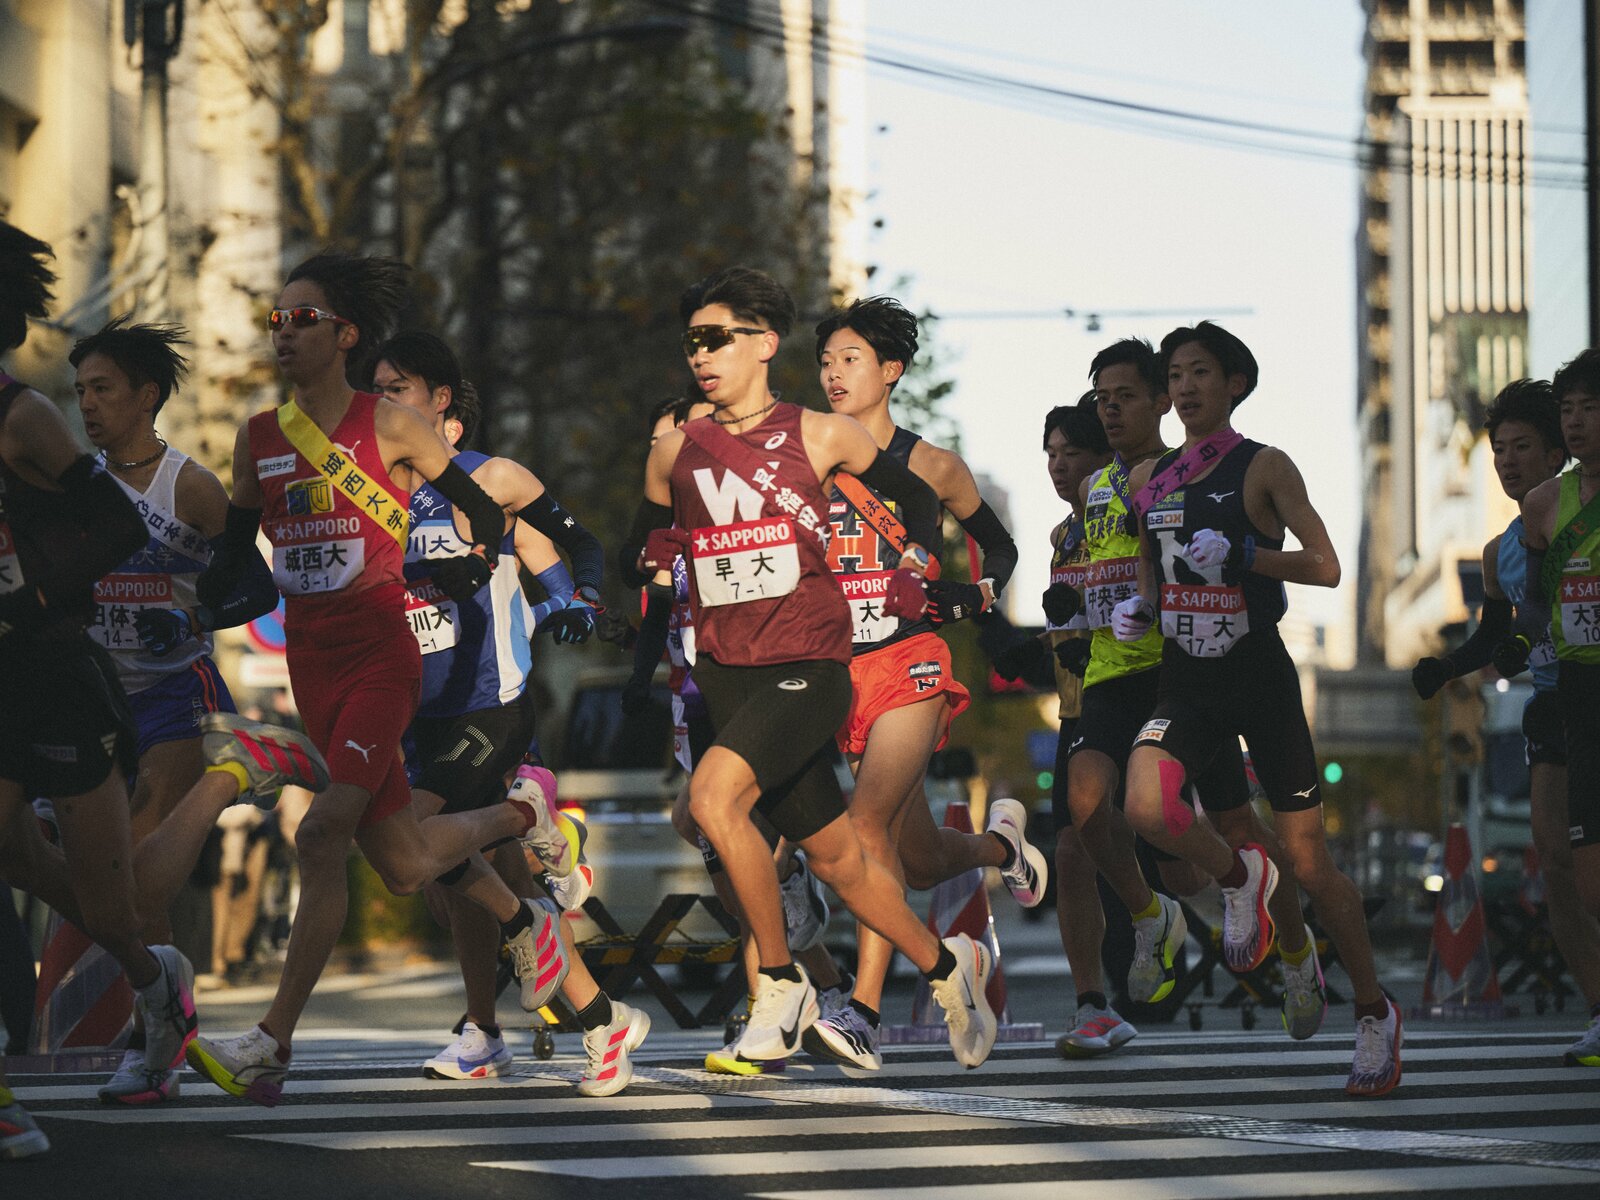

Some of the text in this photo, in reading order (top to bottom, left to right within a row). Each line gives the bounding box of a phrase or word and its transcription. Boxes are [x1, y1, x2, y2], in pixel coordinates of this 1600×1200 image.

[320, 452, 403, 531] 城西大学
[287, 516, 361, 540] SAPPORO
[711, 522, 790, 551] SAPPORO
[826, 520, 884, 573] H
[285, 543, 347, 573] 城西大
[300, 573, 330, 591] 3-1
[1096, 562, 1139, 581] APPO
[96, 581, 167, 597] SAPPORO
[730, 582, 764, 600] 7-1
[841, 577, 892, 596] PPOR
[1088, 586, 1138, 608] 中央学
[406, 606, 453, 634] 川大
[1186, 638, 1226, 656] 17-1
